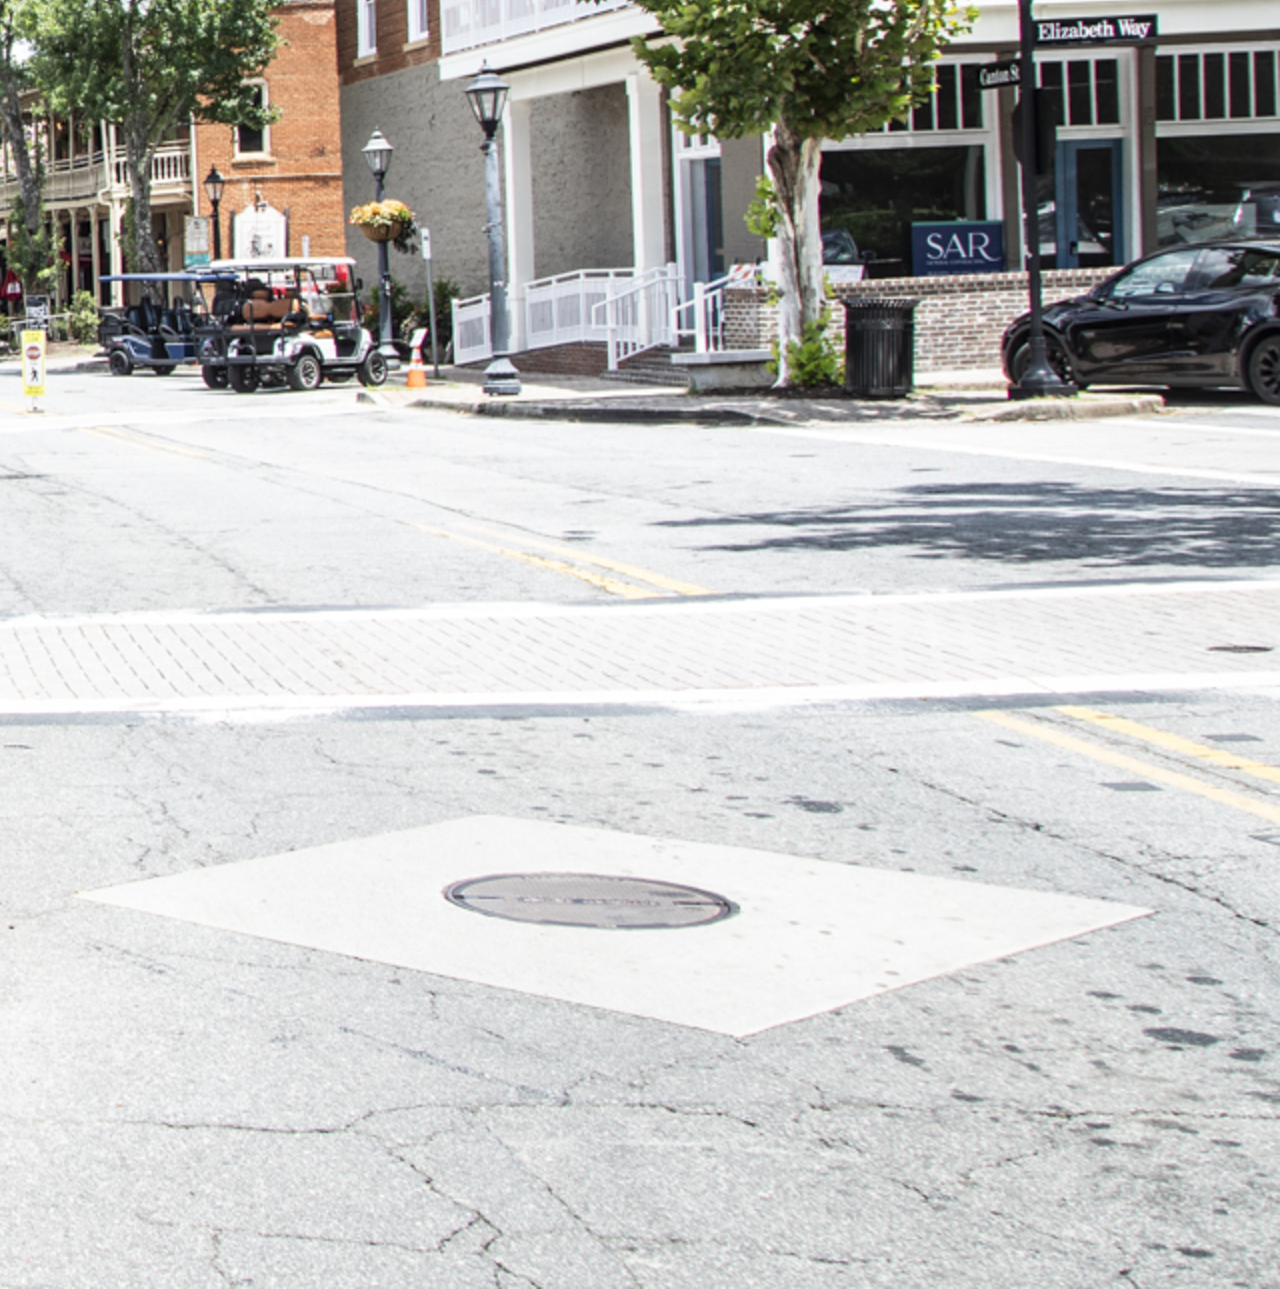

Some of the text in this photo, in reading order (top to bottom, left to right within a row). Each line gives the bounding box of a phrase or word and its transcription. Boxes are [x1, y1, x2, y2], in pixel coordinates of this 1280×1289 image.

[1037, 17, 1152, 41] Elizabeth Way
[925, 232, 1002, 262] SAR
